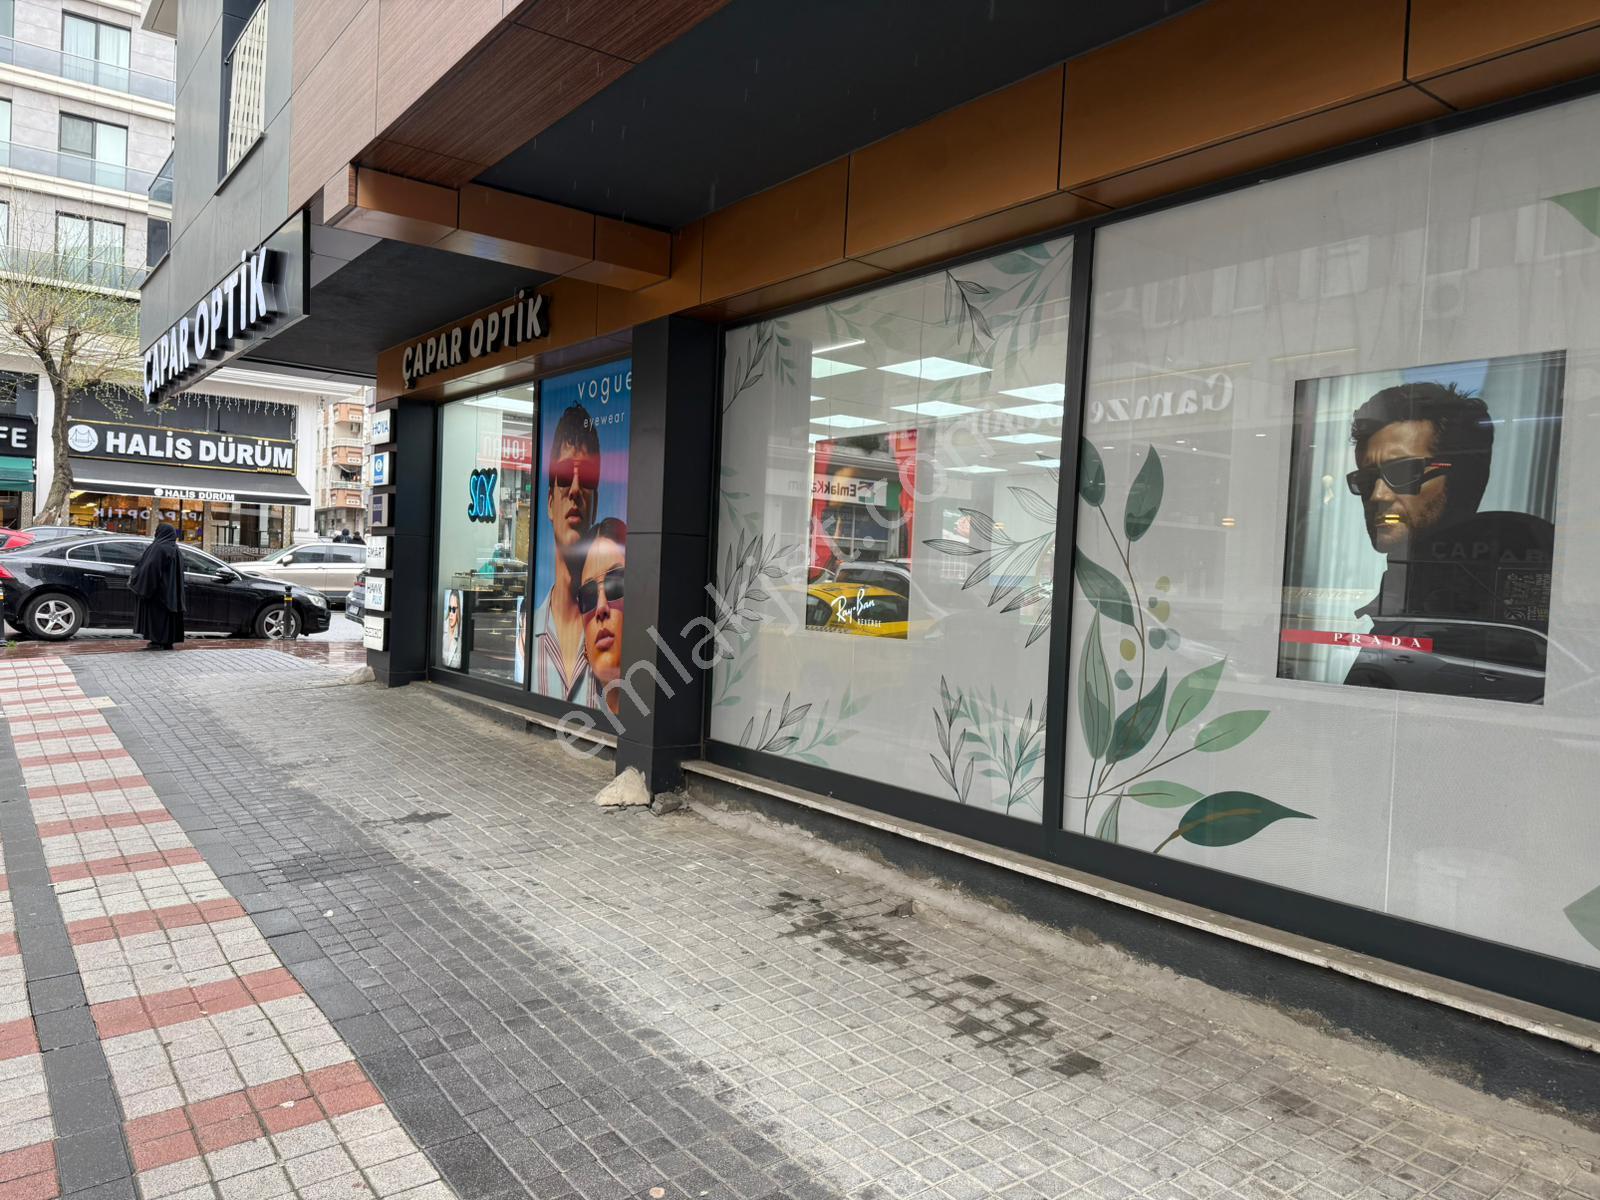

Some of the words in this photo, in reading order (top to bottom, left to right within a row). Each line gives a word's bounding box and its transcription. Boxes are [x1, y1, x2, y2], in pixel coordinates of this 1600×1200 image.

[194, 246, 267, 360] OPTİK
[402, 326, 462, 388] ÇAPAR
[469, 289, 544, 357] OPTİK
[577, 371, 632, 404] vogue
[583, 411, 625, 431] eyewear
[106, 430, 193, 459] HALİS
[199, 436, 293, 469] DÜRÜM
[165, 488, 196, 499] HALİS
[199, 491, 235, 501] DÜRÜM
[469, 471, 496, 519] SGK
[1333, 631, 1422, 648] PRADA
